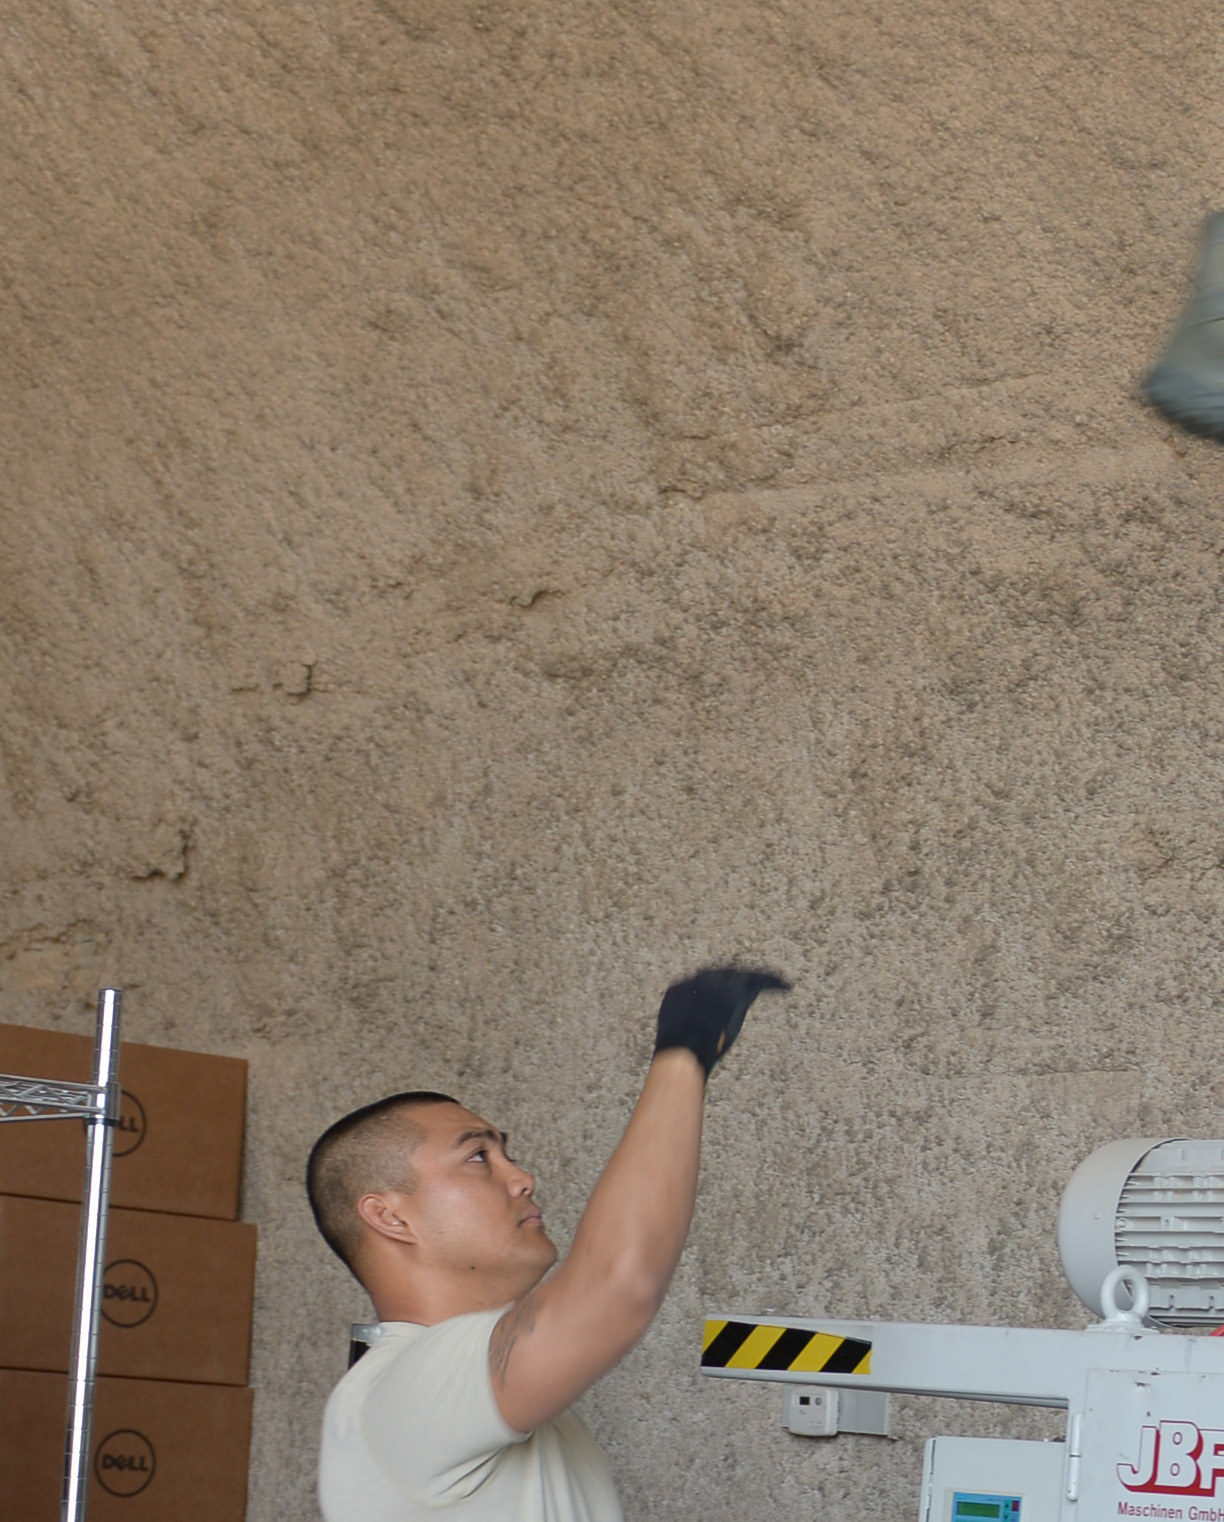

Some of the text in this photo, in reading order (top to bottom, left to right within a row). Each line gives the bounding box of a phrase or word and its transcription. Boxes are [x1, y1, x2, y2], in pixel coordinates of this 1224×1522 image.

[103, 1284, 150, 1302] DELL
[101, 1454, 148, 1473] DELL
[1117, 1501, 1183, 1520] Maschinen
